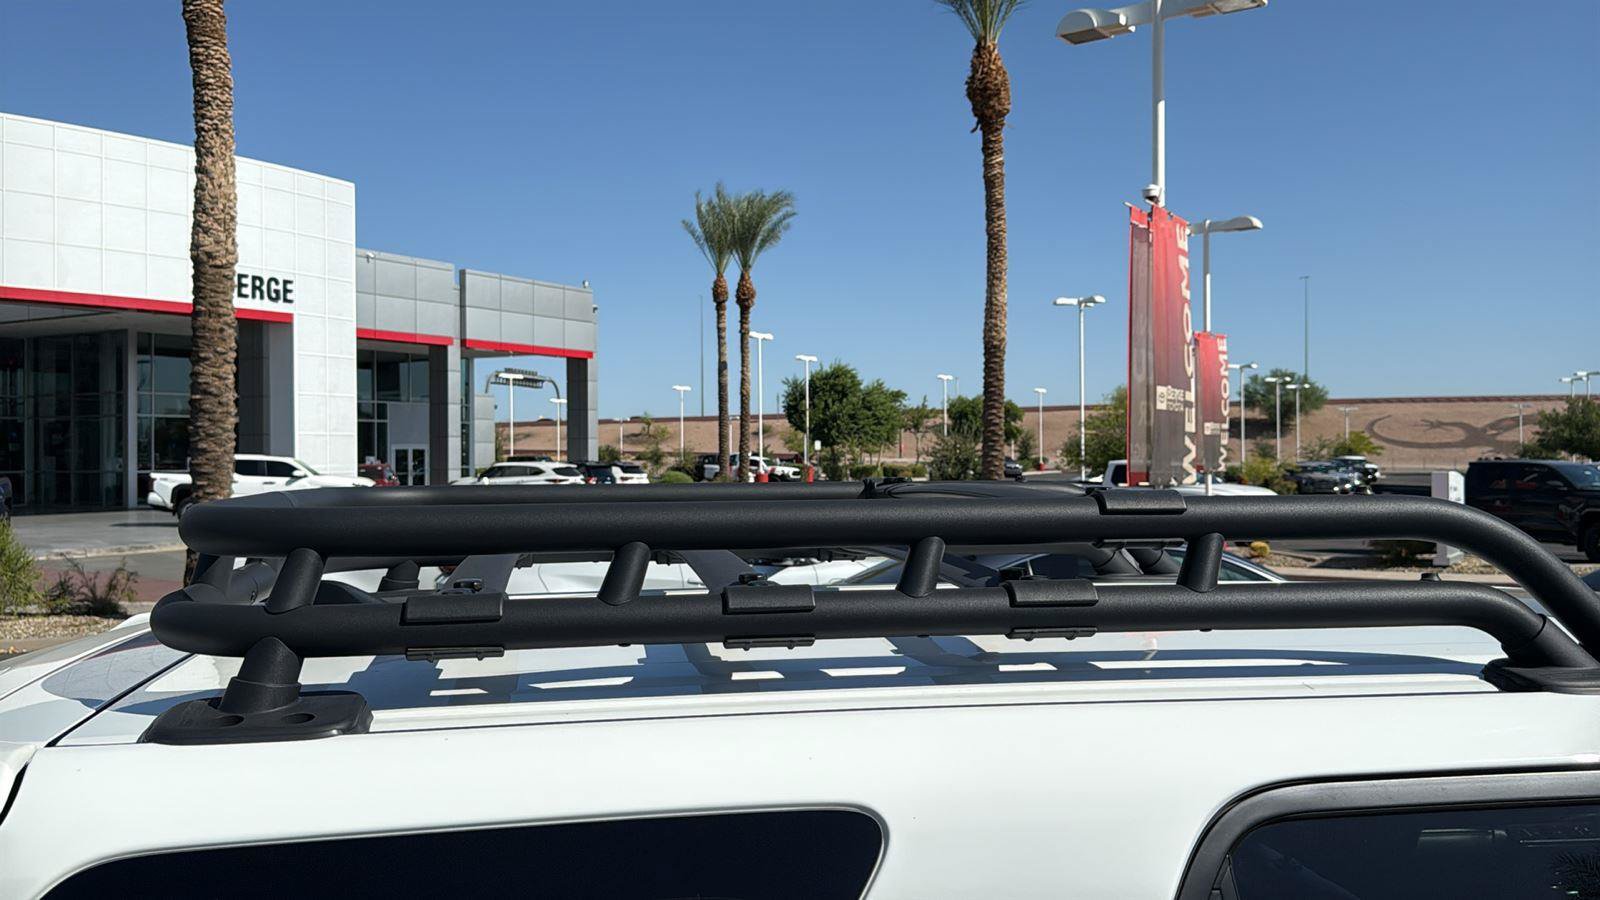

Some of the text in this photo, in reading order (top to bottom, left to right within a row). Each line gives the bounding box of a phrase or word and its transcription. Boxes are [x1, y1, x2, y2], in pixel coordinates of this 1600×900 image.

[237, 273, 295, 304] ERGE
[1176, 223, 1197, 485] WELCOME
[1217, 337, 1230, 472] WELCOME
